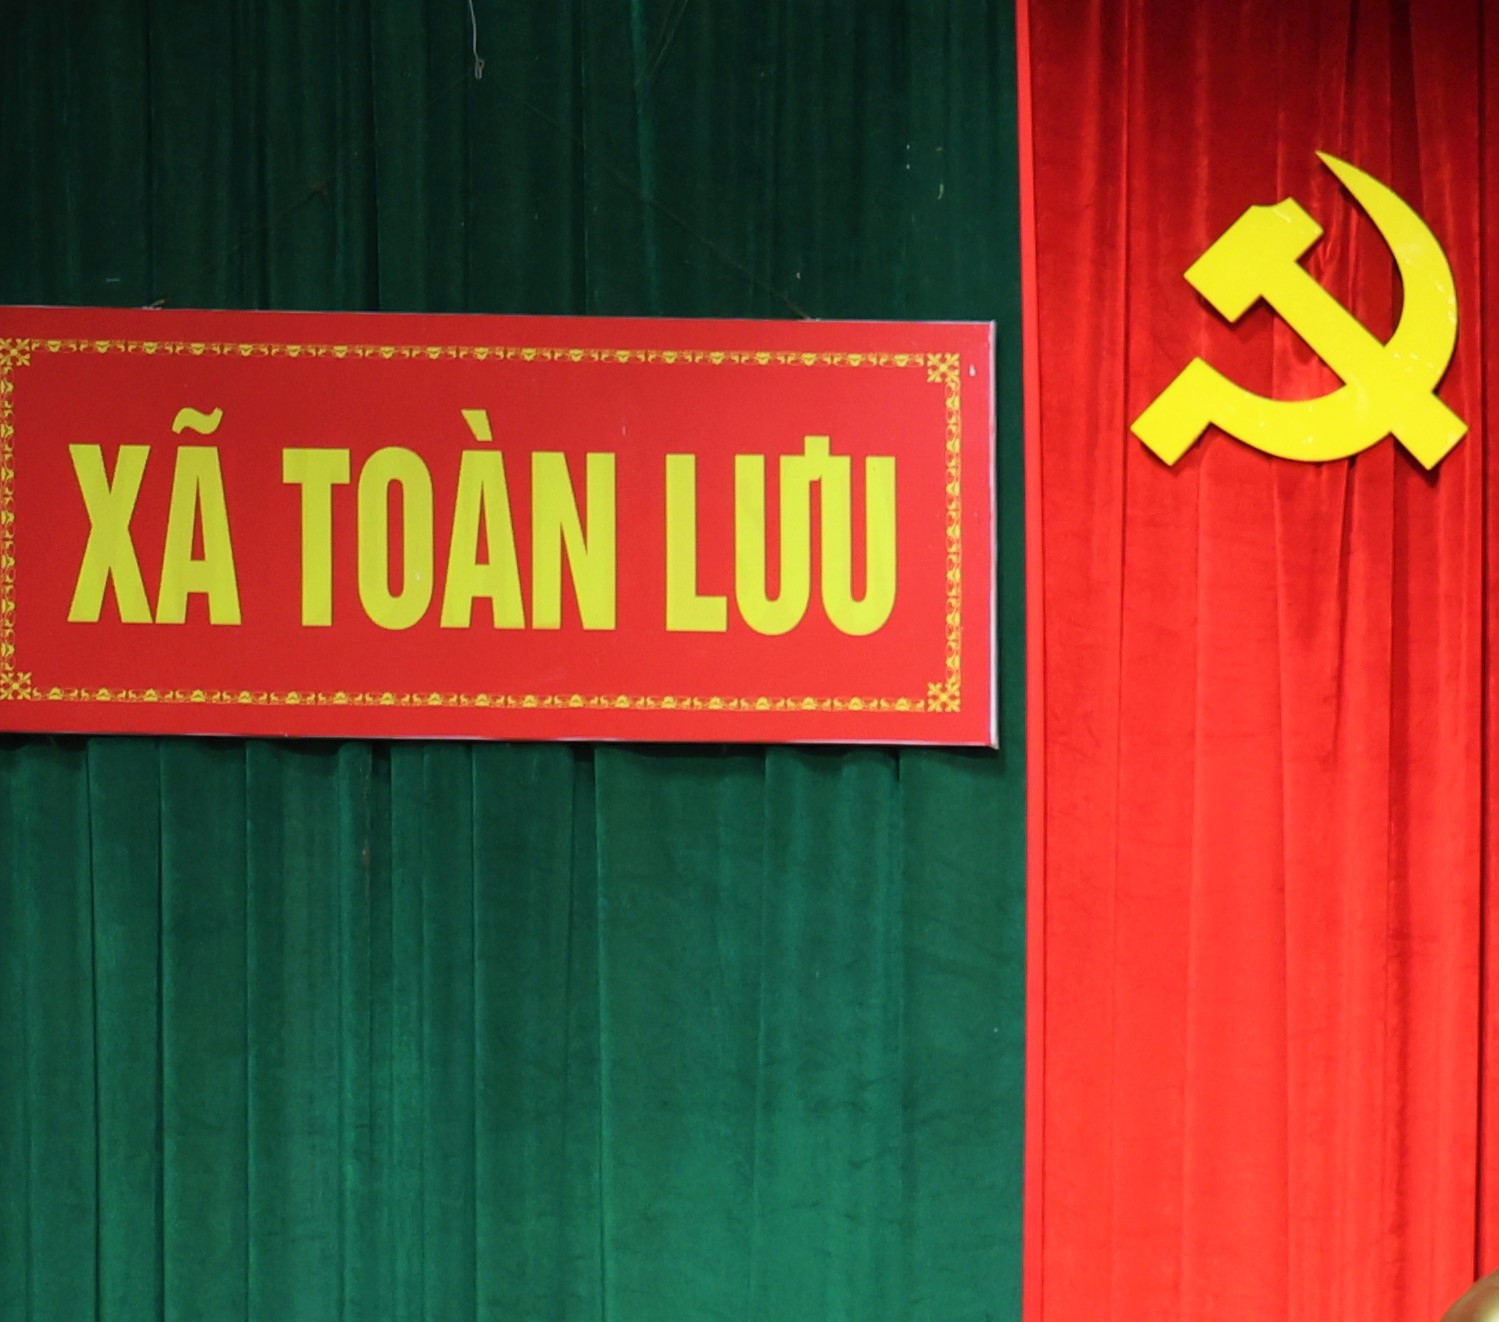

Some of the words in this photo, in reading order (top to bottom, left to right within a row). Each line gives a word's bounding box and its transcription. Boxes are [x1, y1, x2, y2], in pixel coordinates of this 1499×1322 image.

[68, 407, 242, 625] XÃ
[282, 409, 617, 631] TOÀN
[665, 435, 897, 635] LƯU
